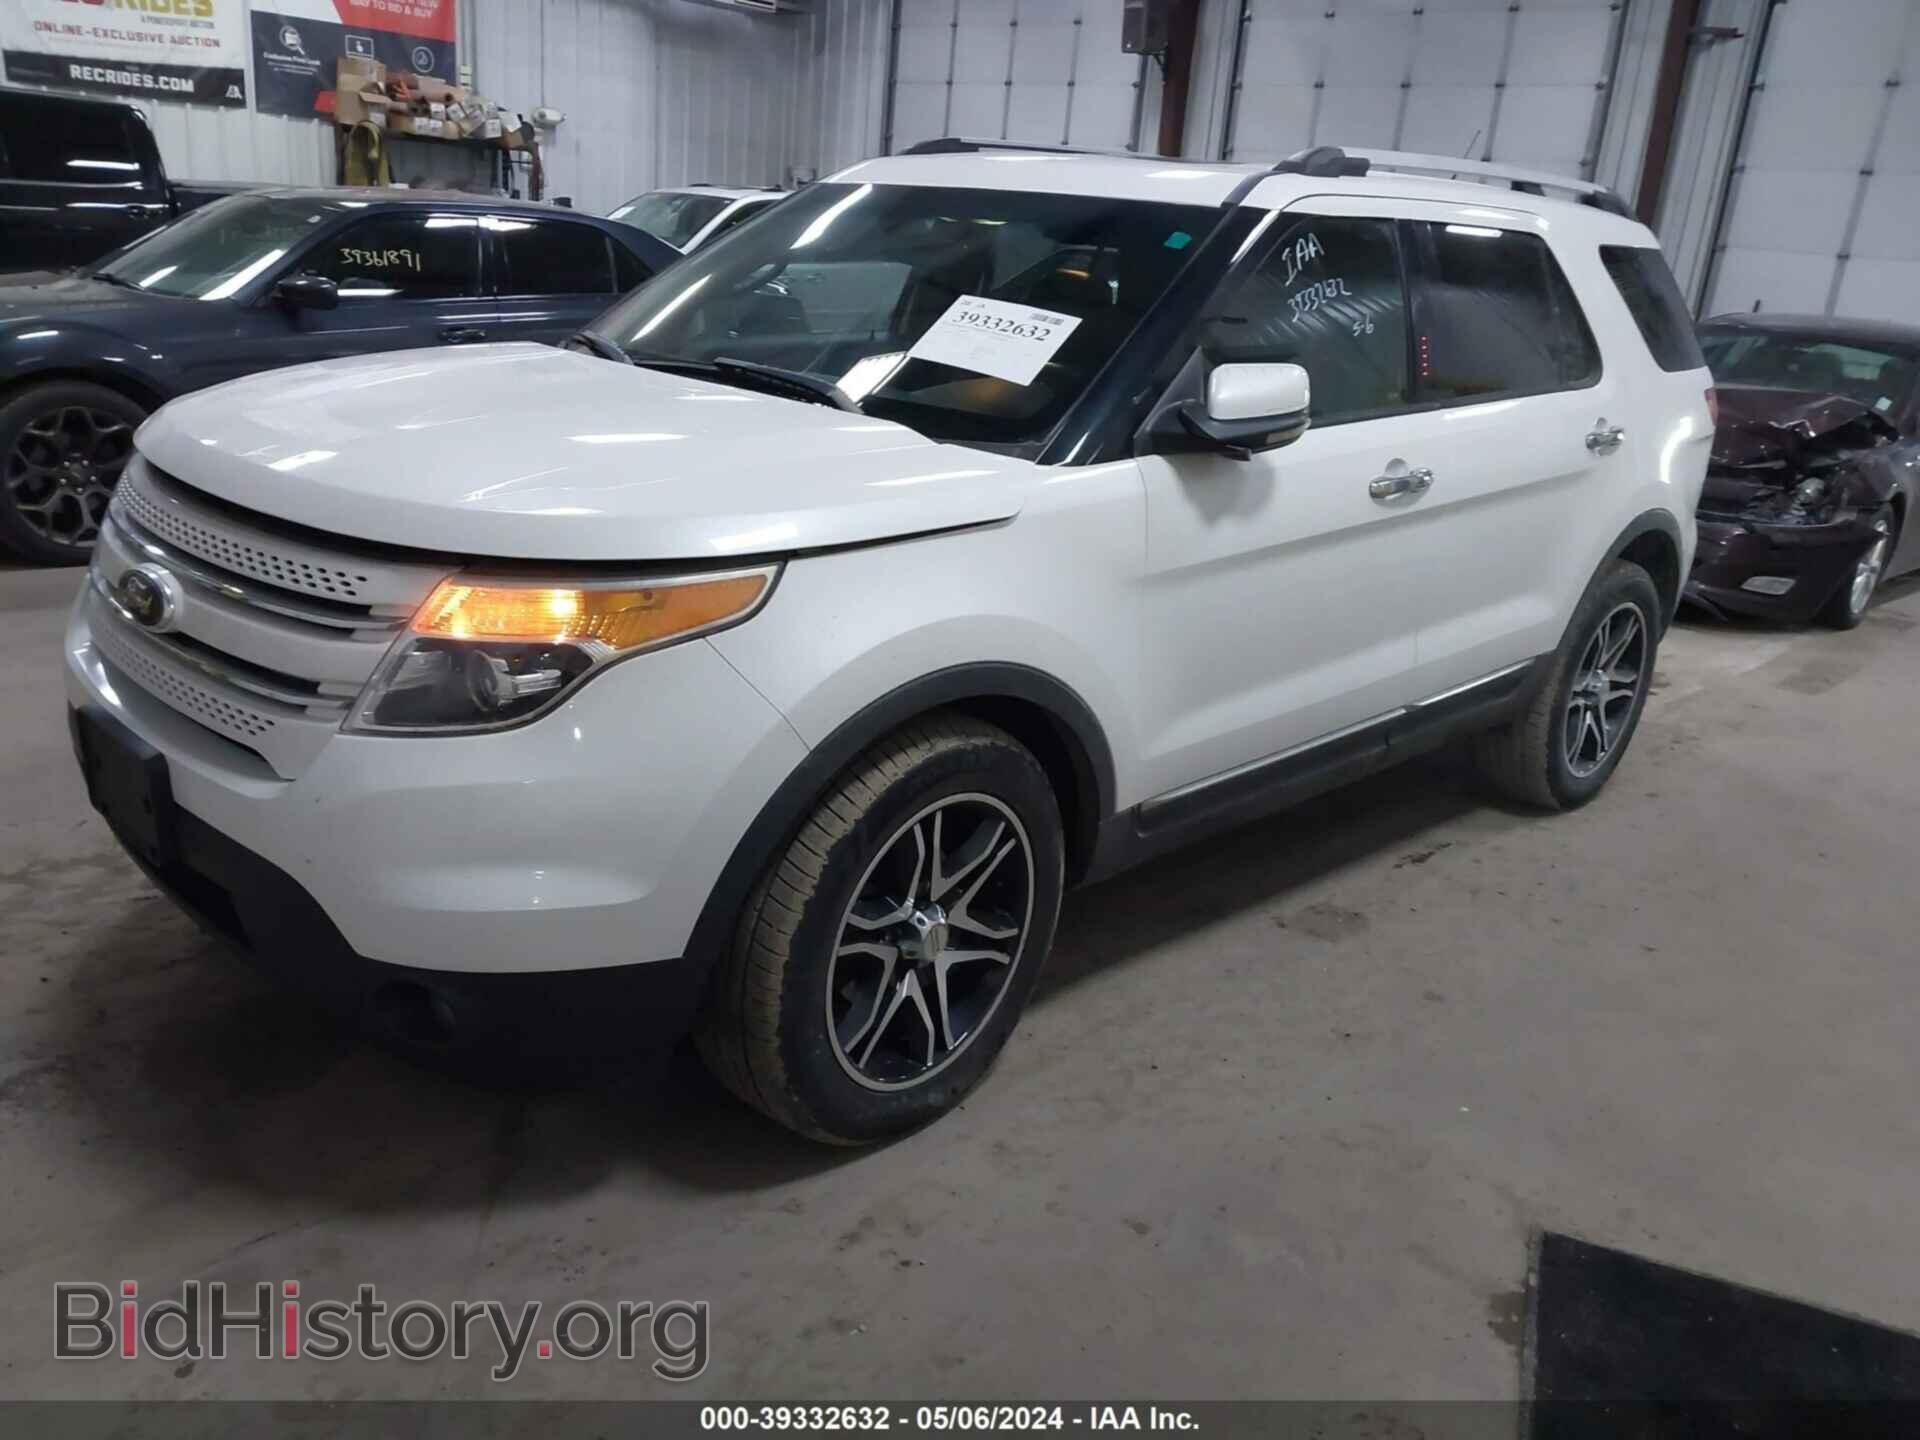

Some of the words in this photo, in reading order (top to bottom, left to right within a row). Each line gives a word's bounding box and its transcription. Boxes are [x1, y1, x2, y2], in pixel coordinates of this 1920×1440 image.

[33, 20, 164, 44] ONLINE-EXCLUSIVE
[168, 35, 221, 48] AUCTION
[69, 64, 194, 93] RECRIDES.COM
[340, 248, 421, 272] 39361891
[1282, 232, 1325, 287] IAA
[952, 311, 1051, 341] 39332632
